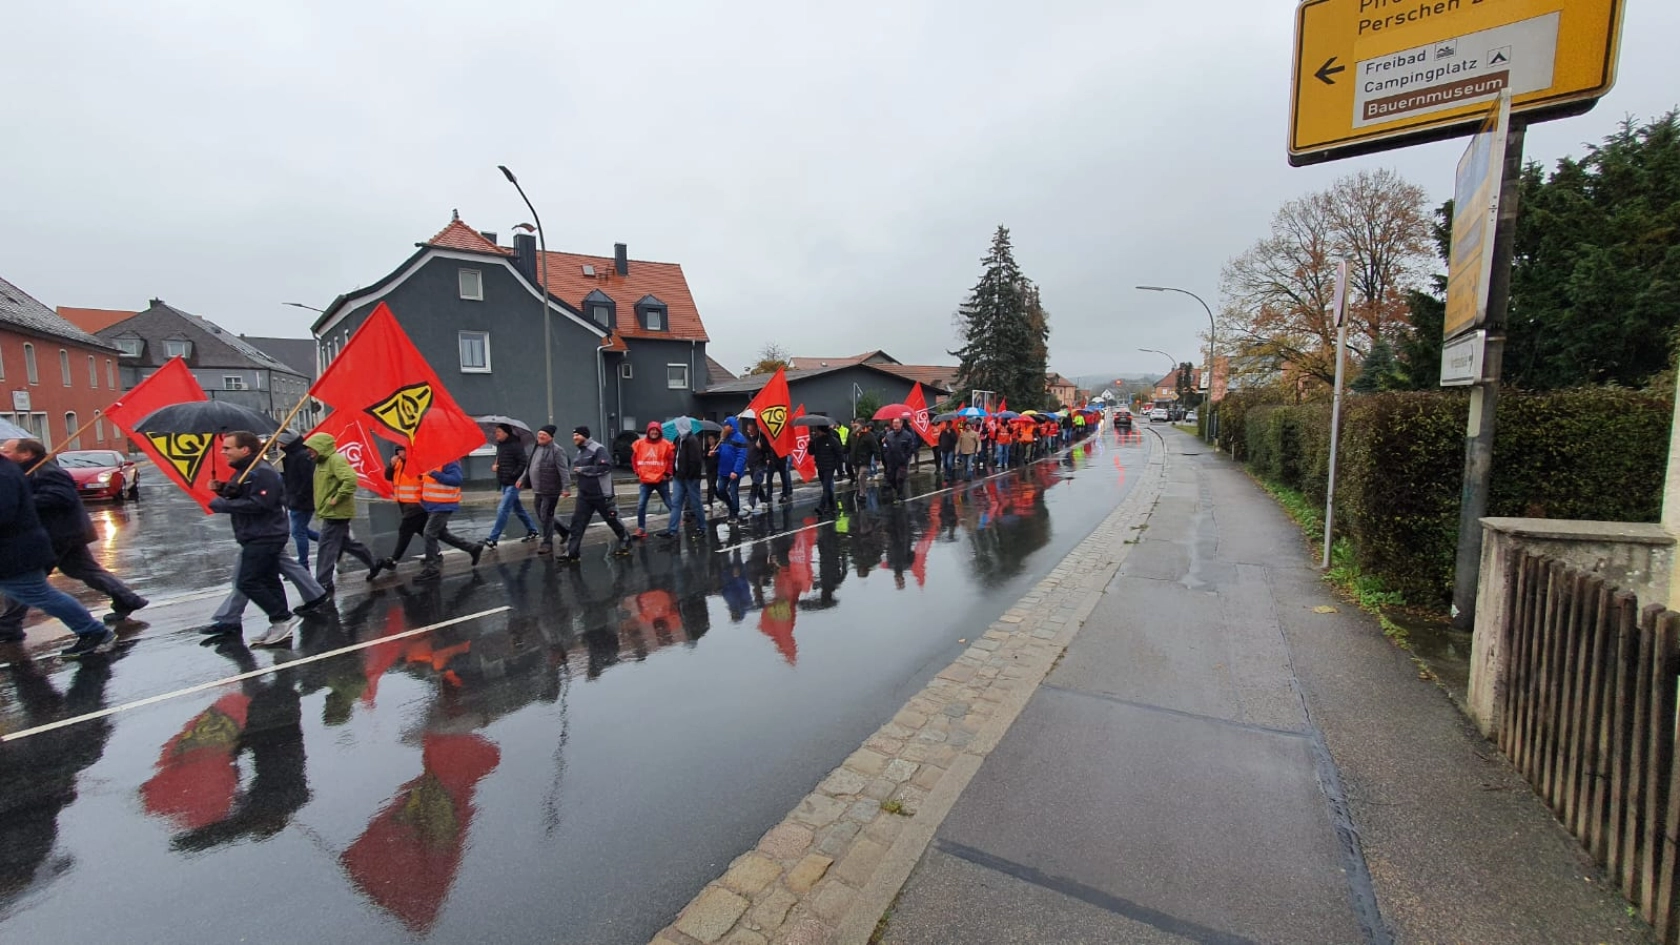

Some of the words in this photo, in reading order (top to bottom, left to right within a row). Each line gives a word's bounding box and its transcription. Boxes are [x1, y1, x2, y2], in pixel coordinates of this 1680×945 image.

[1358, 0, 1459, 35] Perschen
[1364, 59, 1477, 93] Campingplatz
[1366, 50, 1426, 75] Freibad
[1368, 78, 1503, 116] Bauernmuseum
